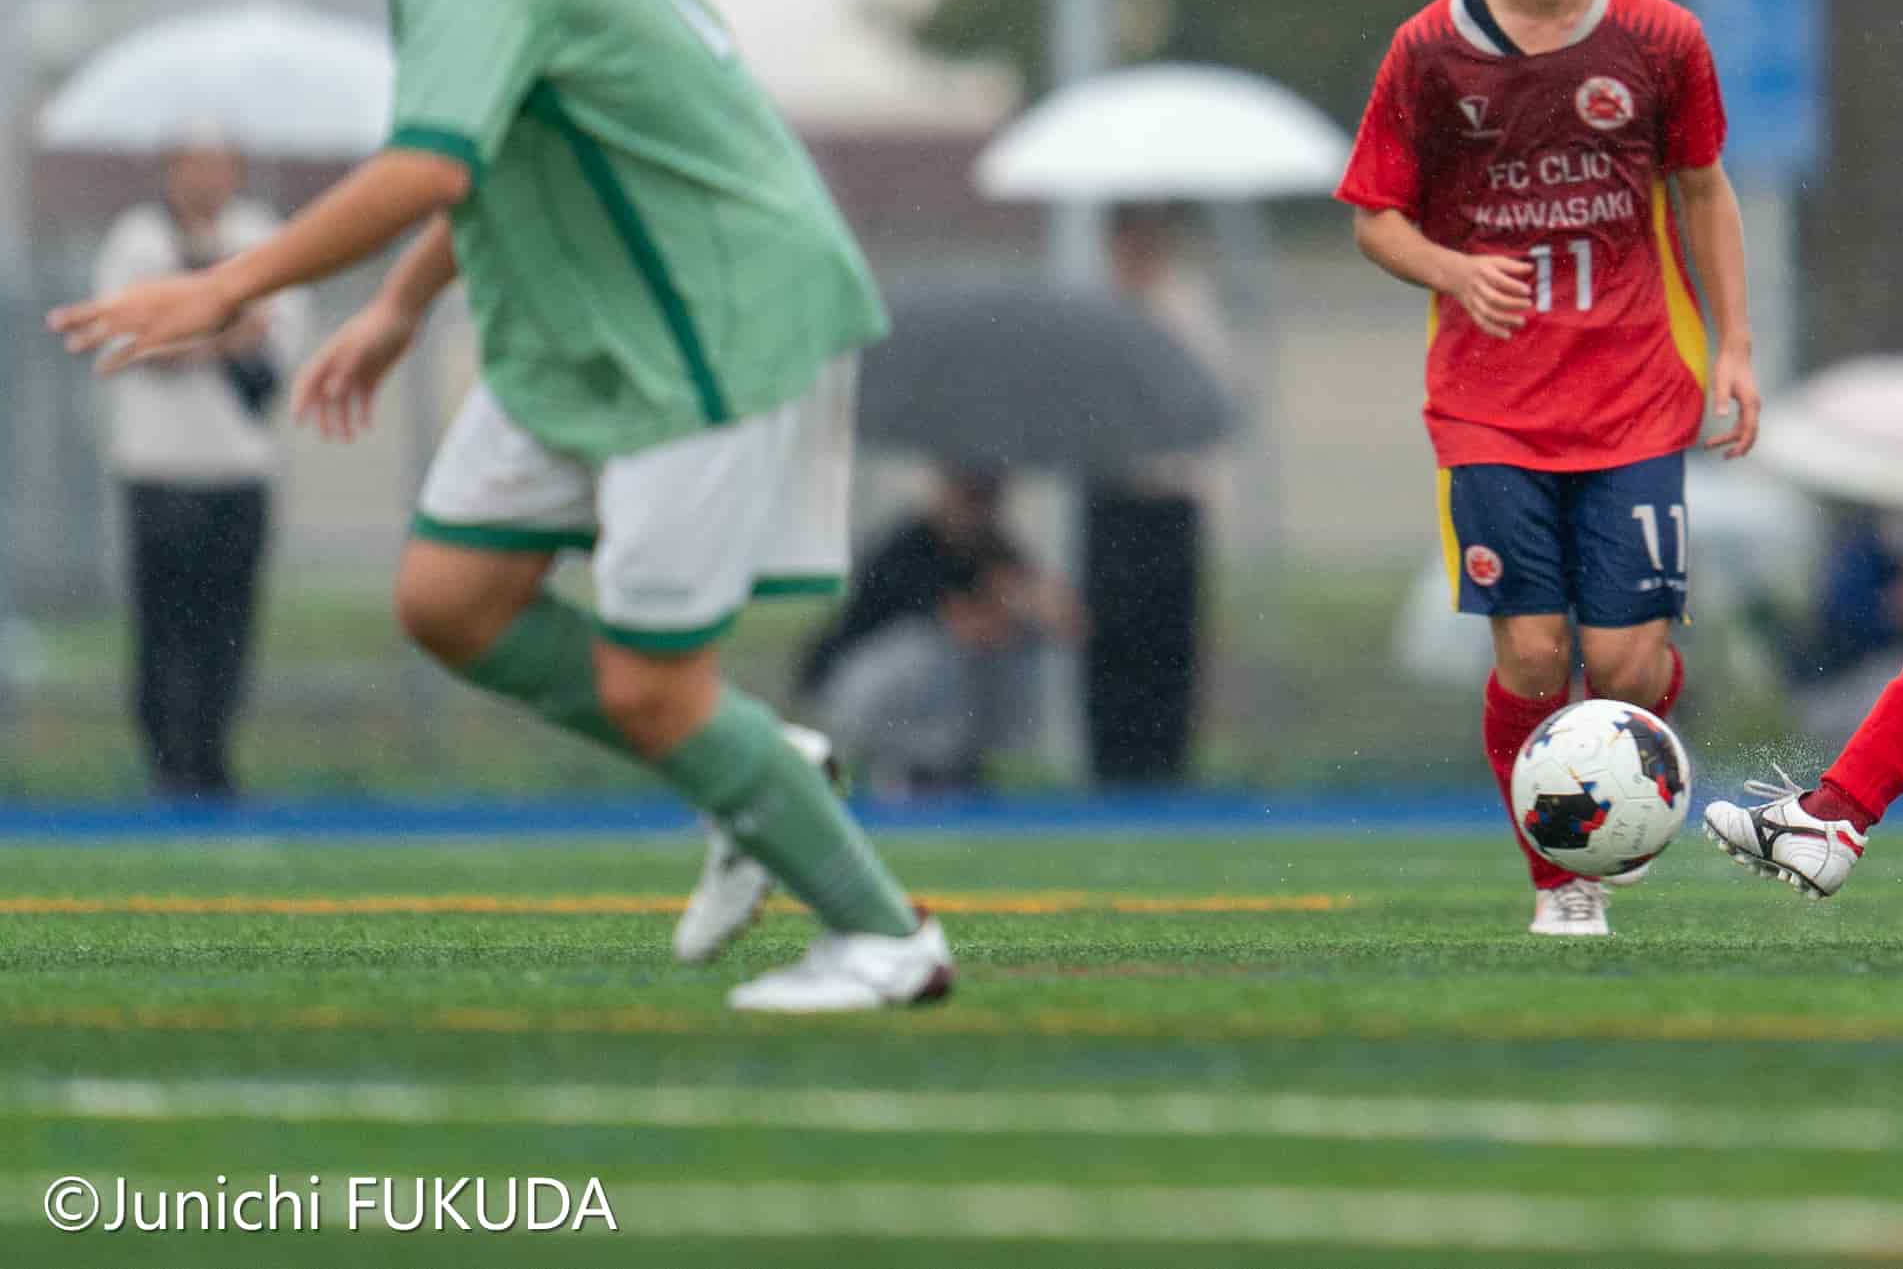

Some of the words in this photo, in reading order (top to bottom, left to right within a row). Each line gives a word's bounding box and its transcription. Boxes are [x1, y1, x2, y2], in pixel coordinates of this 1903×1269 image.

[1489, 160, 1531, 190] FC
[1539, 151, 1612, 186] CLIO
[1473, 189, 1634, 230] KAWASAKI
[1529, 239, 1593, 313] 11
[1631, 504, 1685, 573] 11
